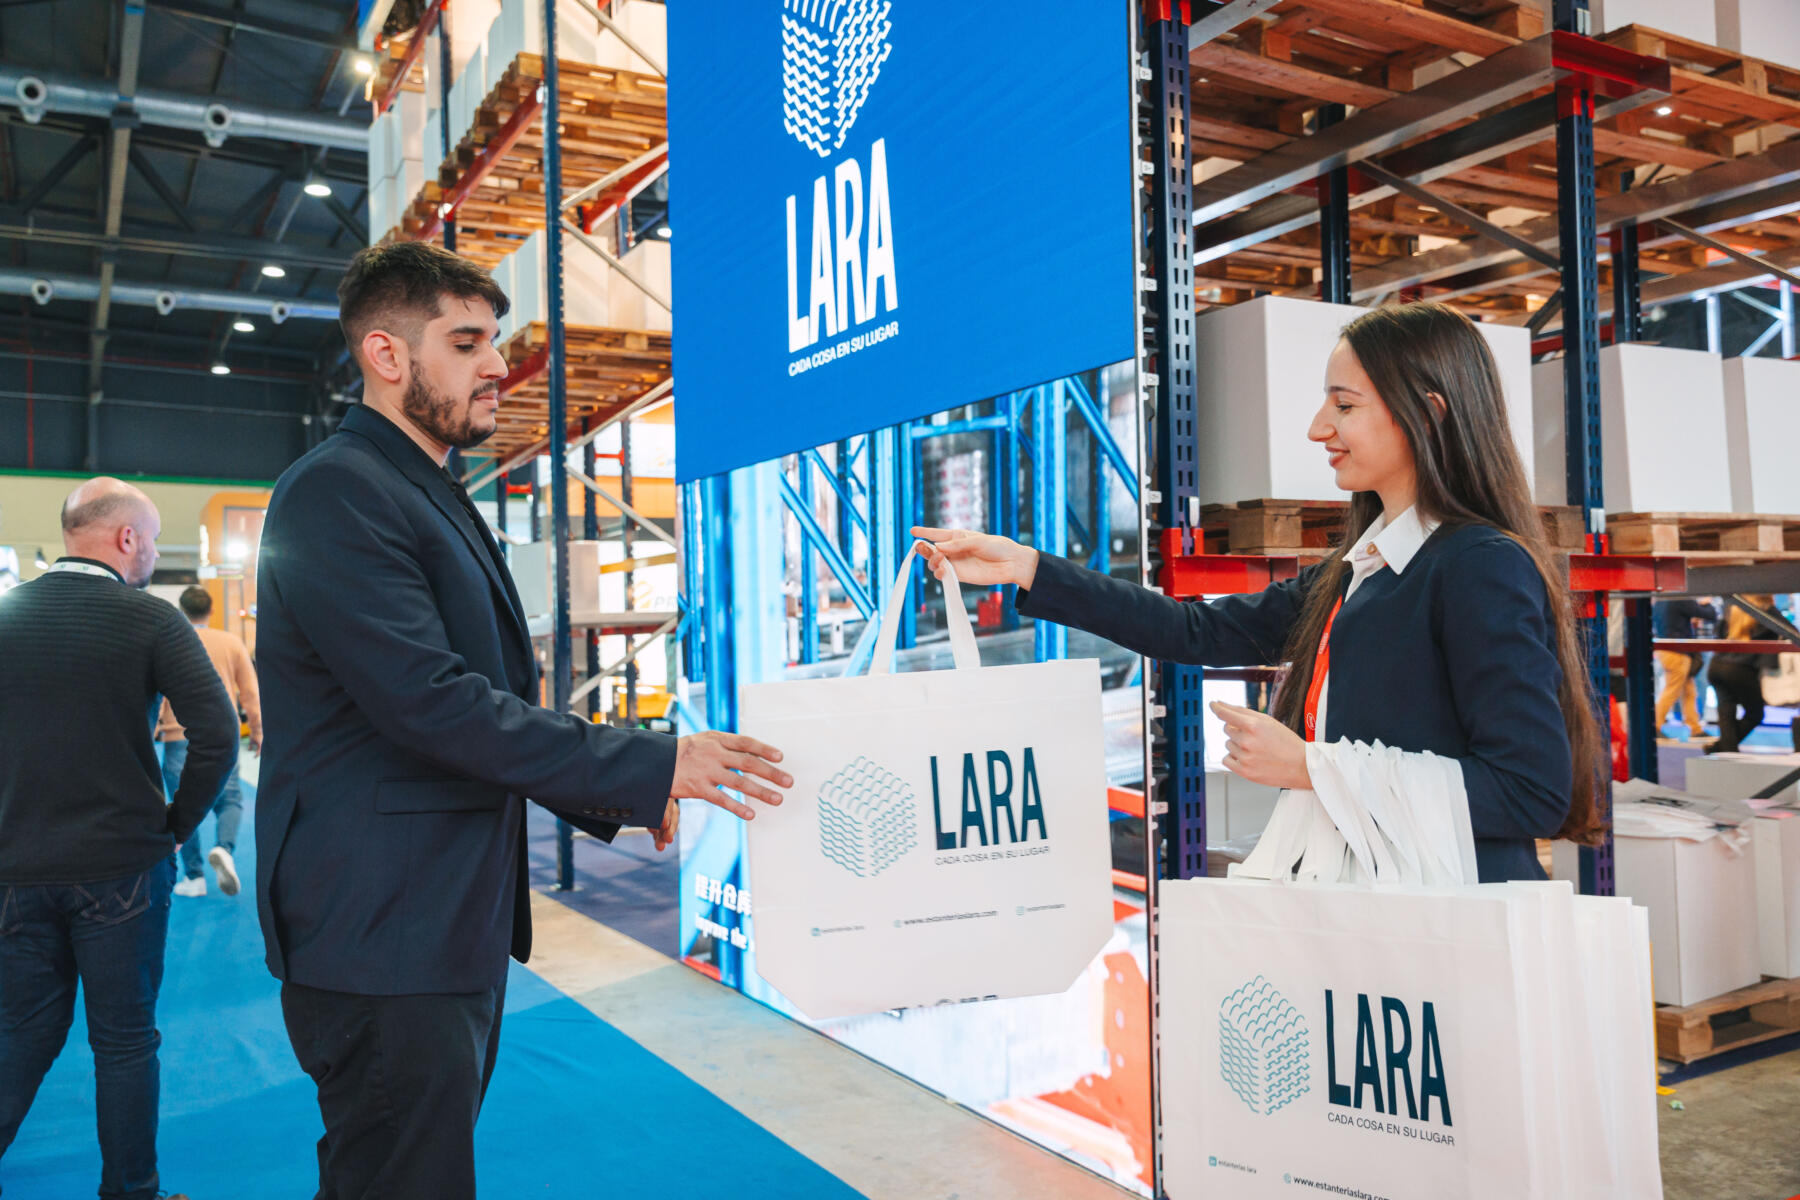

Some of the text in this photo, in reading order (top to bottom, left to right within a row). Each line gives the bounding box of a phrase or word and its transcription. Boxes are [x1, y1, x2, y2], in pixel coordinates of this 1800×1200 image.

[786, 137, 898, 353] LARA
[788, 321, 899, 376] CADA COSA EN SU LUGAR
[930, 747, 1048, 850] LARA
[936, 856, 960, 865] CADA
[963, 854, 988, 863] COSA
[991, 851, 1003, 860] EN
[1020, 846, 1049, 857] LUGAR
[1325, 989, 1453, 1127] LARA
[1328, 1112, 1455, 1146] CADA COSA EN SU LUGAR
